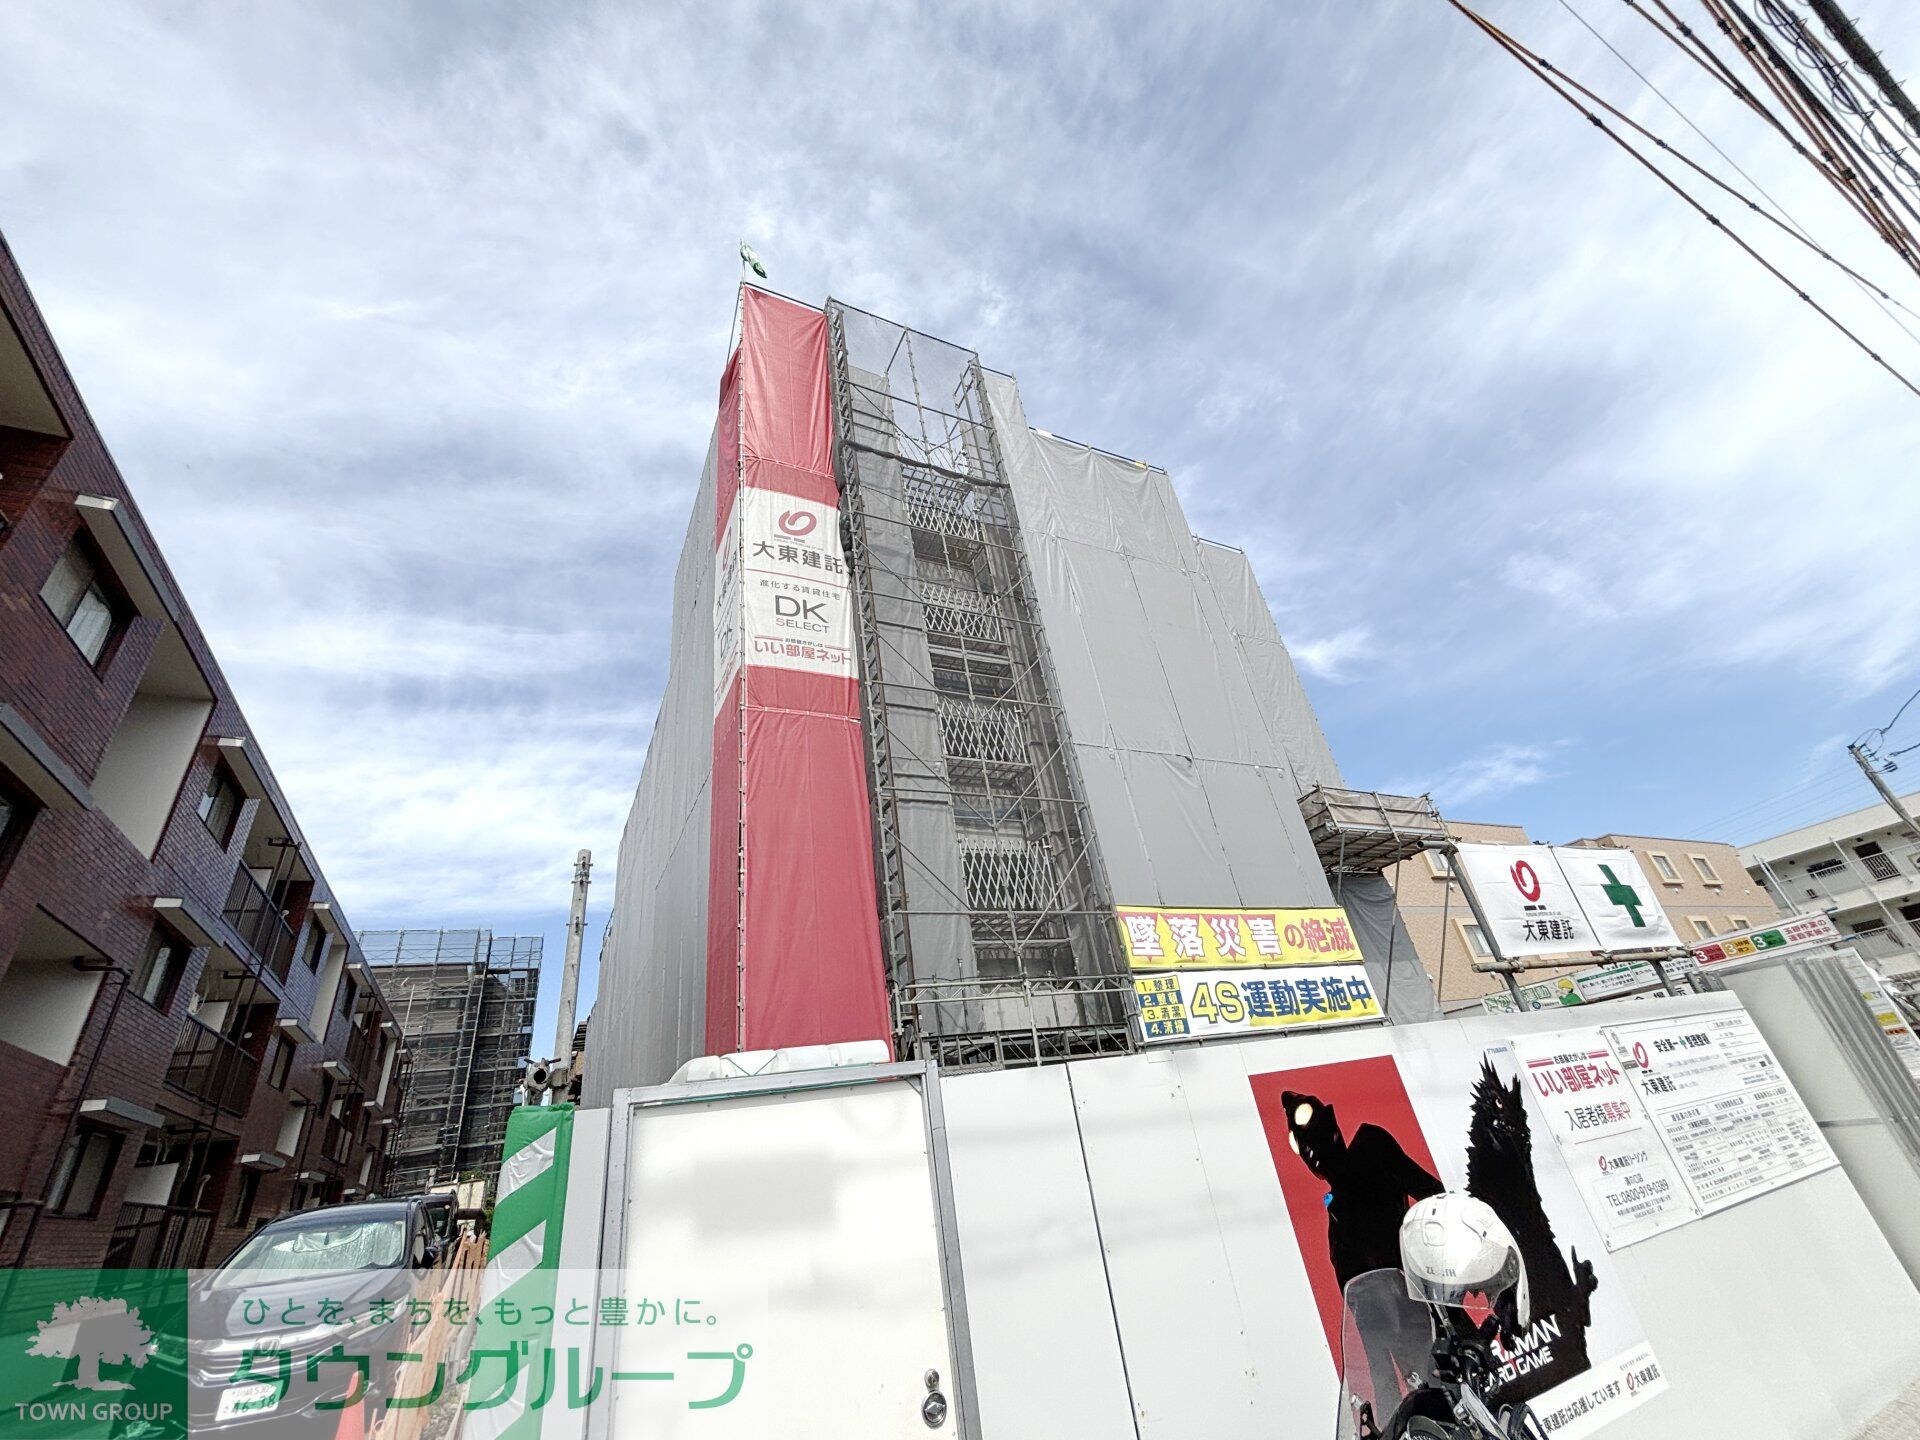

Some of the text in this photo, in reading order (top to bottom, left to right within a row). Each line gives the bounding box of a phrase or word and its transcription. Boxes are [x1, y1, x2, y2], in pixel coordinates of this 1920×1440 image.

[753, 541, 843, 575] 大東建託
[760, 579, 841, 600] 進化する賃貸住宅
[774, 595, 830, 623] DK
[776, 618, 831, 634] SELECT
[754, 641, 851, 665] いい部屋ネット
[1125, 915, 1355, 958] 墜落災害の絶滅
[1522, 919, 1575, 942] 大東建託
[1190, 976, 1372, 1024] 4S運動実施中
[1531, 1060, 1621, 1097] いい部屋ネット
[1641, 1075, 1677, 1096] 大東建託
[1564, 1099, 1632, 1132] 入居者様募集中
[1516, 1346, 1554, 1375] GAME
[1634, 1363, 1661, 1389] 大東建託
[1540, 1380, 1621, 1438] 東建託は応援しています
